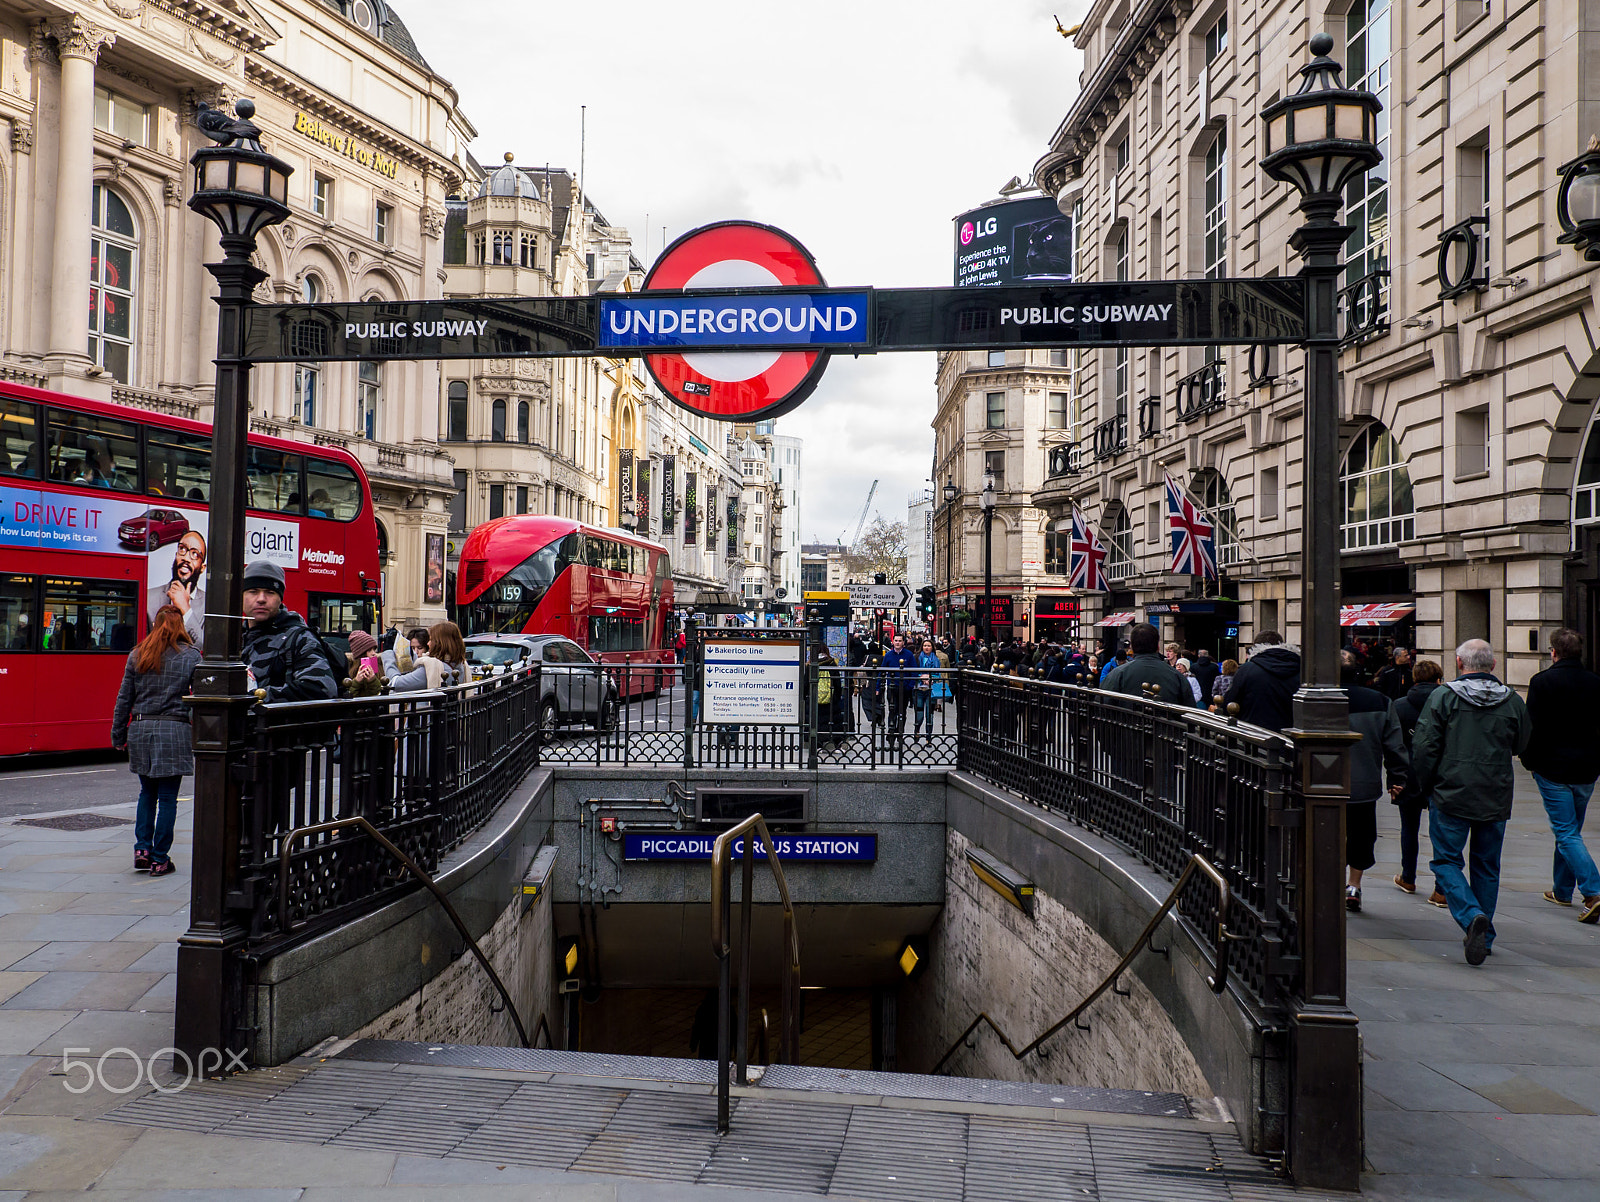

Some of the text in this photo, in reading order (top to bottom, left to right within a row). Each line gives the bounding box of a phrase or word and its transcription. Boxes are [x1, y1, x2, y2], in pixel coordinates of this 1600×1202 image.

[294, 112, 399, 179] Believe It or Not!
[976, 217, 998, 238] LG
[960, 244, 1007, 264] Experience the
[960, 255, 1011, 276] LG OLED 4K TV
[965, 274, 979, 287] John
[979, 269, 998, 280] Lewis
[610, 306, 858, 335] UNDERGROUND
[1000, 303, 1173, 325] PUBLIC SUBWAY
[345, 320, 488, 339] PUBLIC SUBWAY
[14, 501, 77, 527] DRIVE
[85, 509, 102, 529] IT
[0, 526, 98, 543] how London buys its cars
[302, 548, 345, 565] Metroline
[503, 586, 521, 601] 159
[992, 605, 1004, 613] EAK
[749, 647, 763, 655] line
[714, 666, 749, 675] Piccadilly
[641, 840, 859, 854] PICCADIL CRCUS STATION
